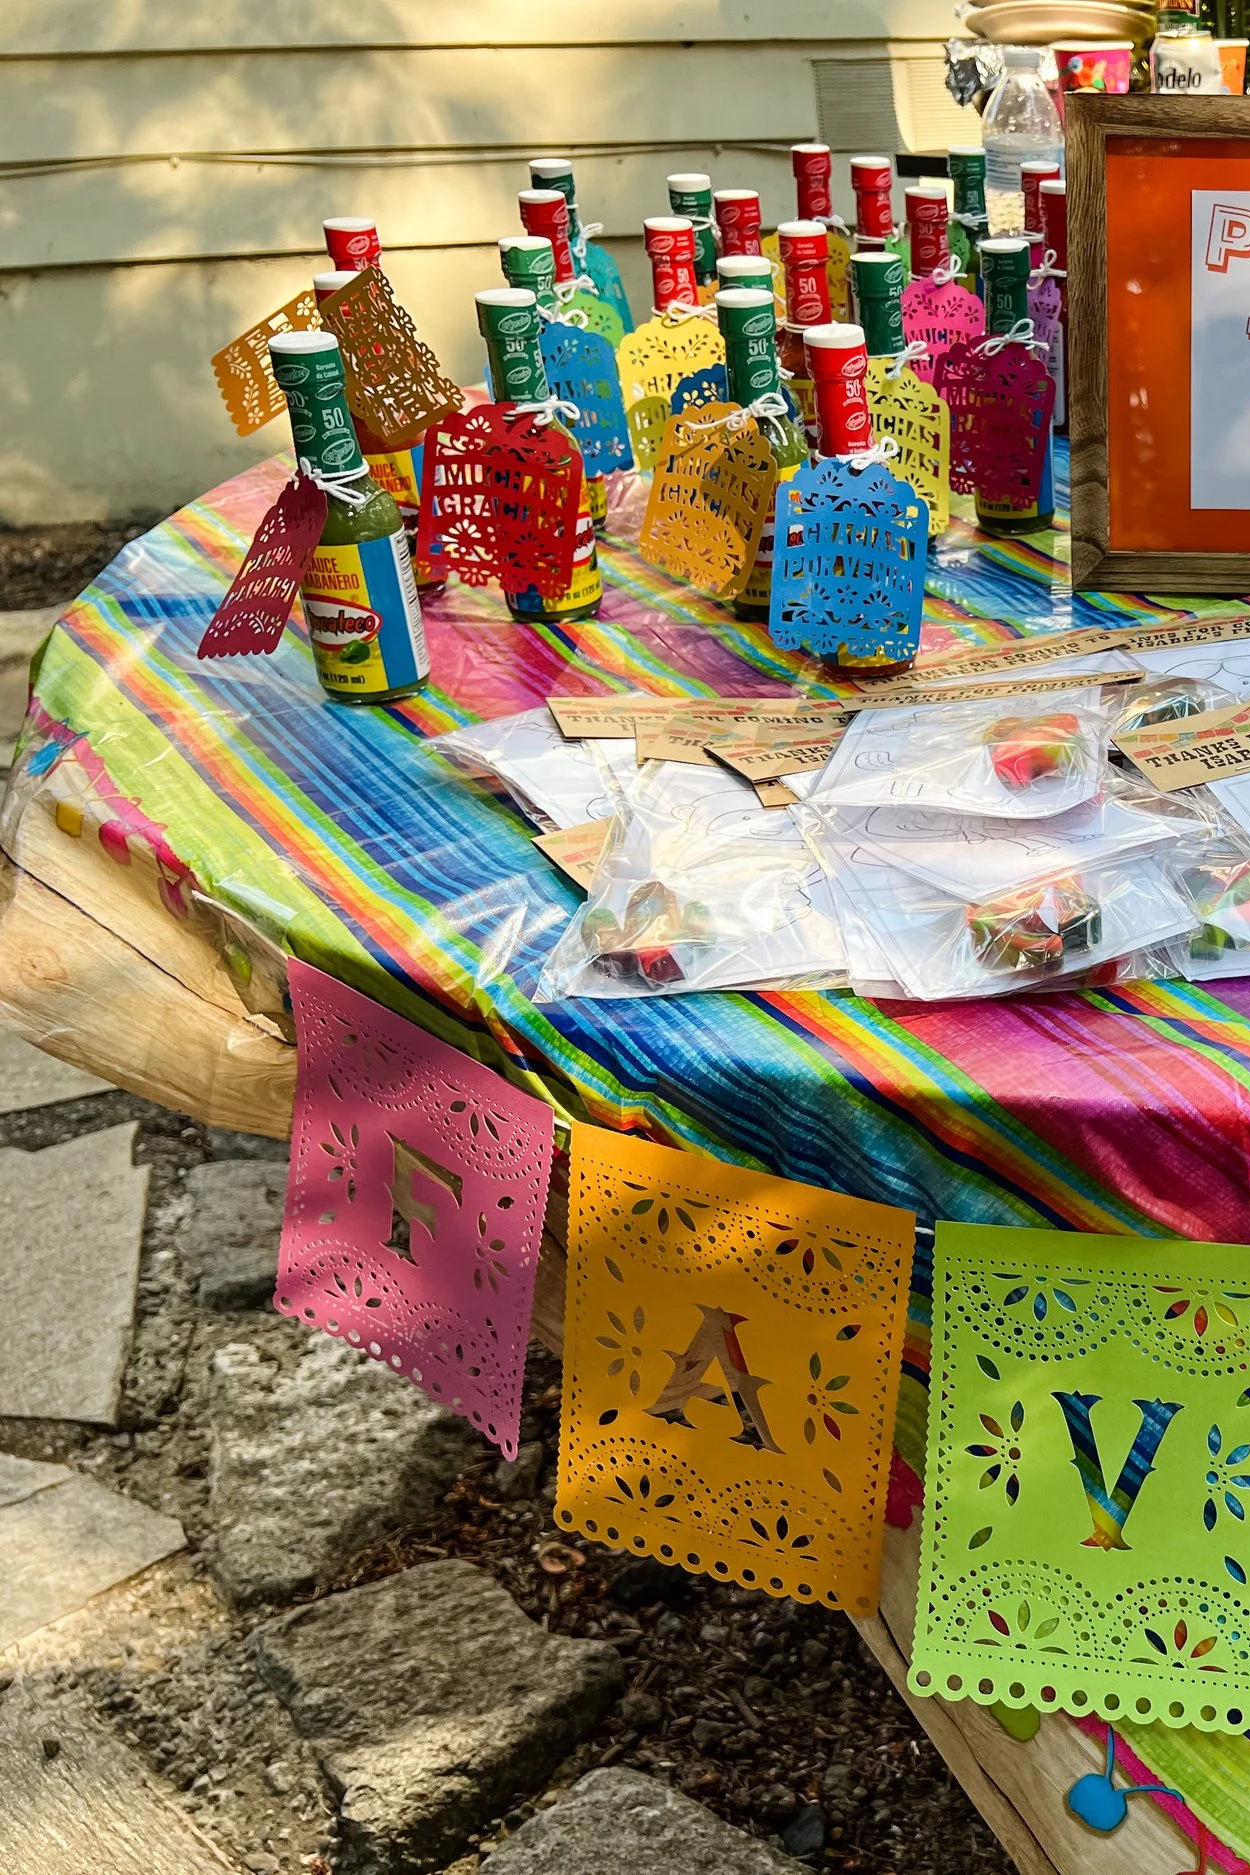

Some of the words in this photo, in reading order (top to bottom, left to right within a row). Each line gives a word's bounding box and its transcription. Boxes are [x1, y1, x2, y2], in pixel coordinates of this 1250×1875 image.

[537, 275, 552, 289] 50
[799, 278, 817, 293] 50
[997, 294, 1013, 310] 50
[505, 338, 525, 352] 50
[749, 338, 768, 355] 50
[846, 379, 862, 397] 50
[322, 408, 345, 429] 50
[370, 462, 397, 477] AUCE
[379, 475, 412, 493] ANERO
[1187, 624, 1225, 637] FOR
[1137, 631, 1223, 649] ISABEL'S
[962, 659, 998, 669] FOR
[1002, 642, 1080, 661] COMING
[1085, 635, 1112, 645] TO
[733, 716, 824, 724] COMING
[1145, 737, 1241, 769] THANKS
[385, 1128, 465, 1267] F
[643, 1303, 788, 1456] A
[1050, 1389, 1186, 1552] V
